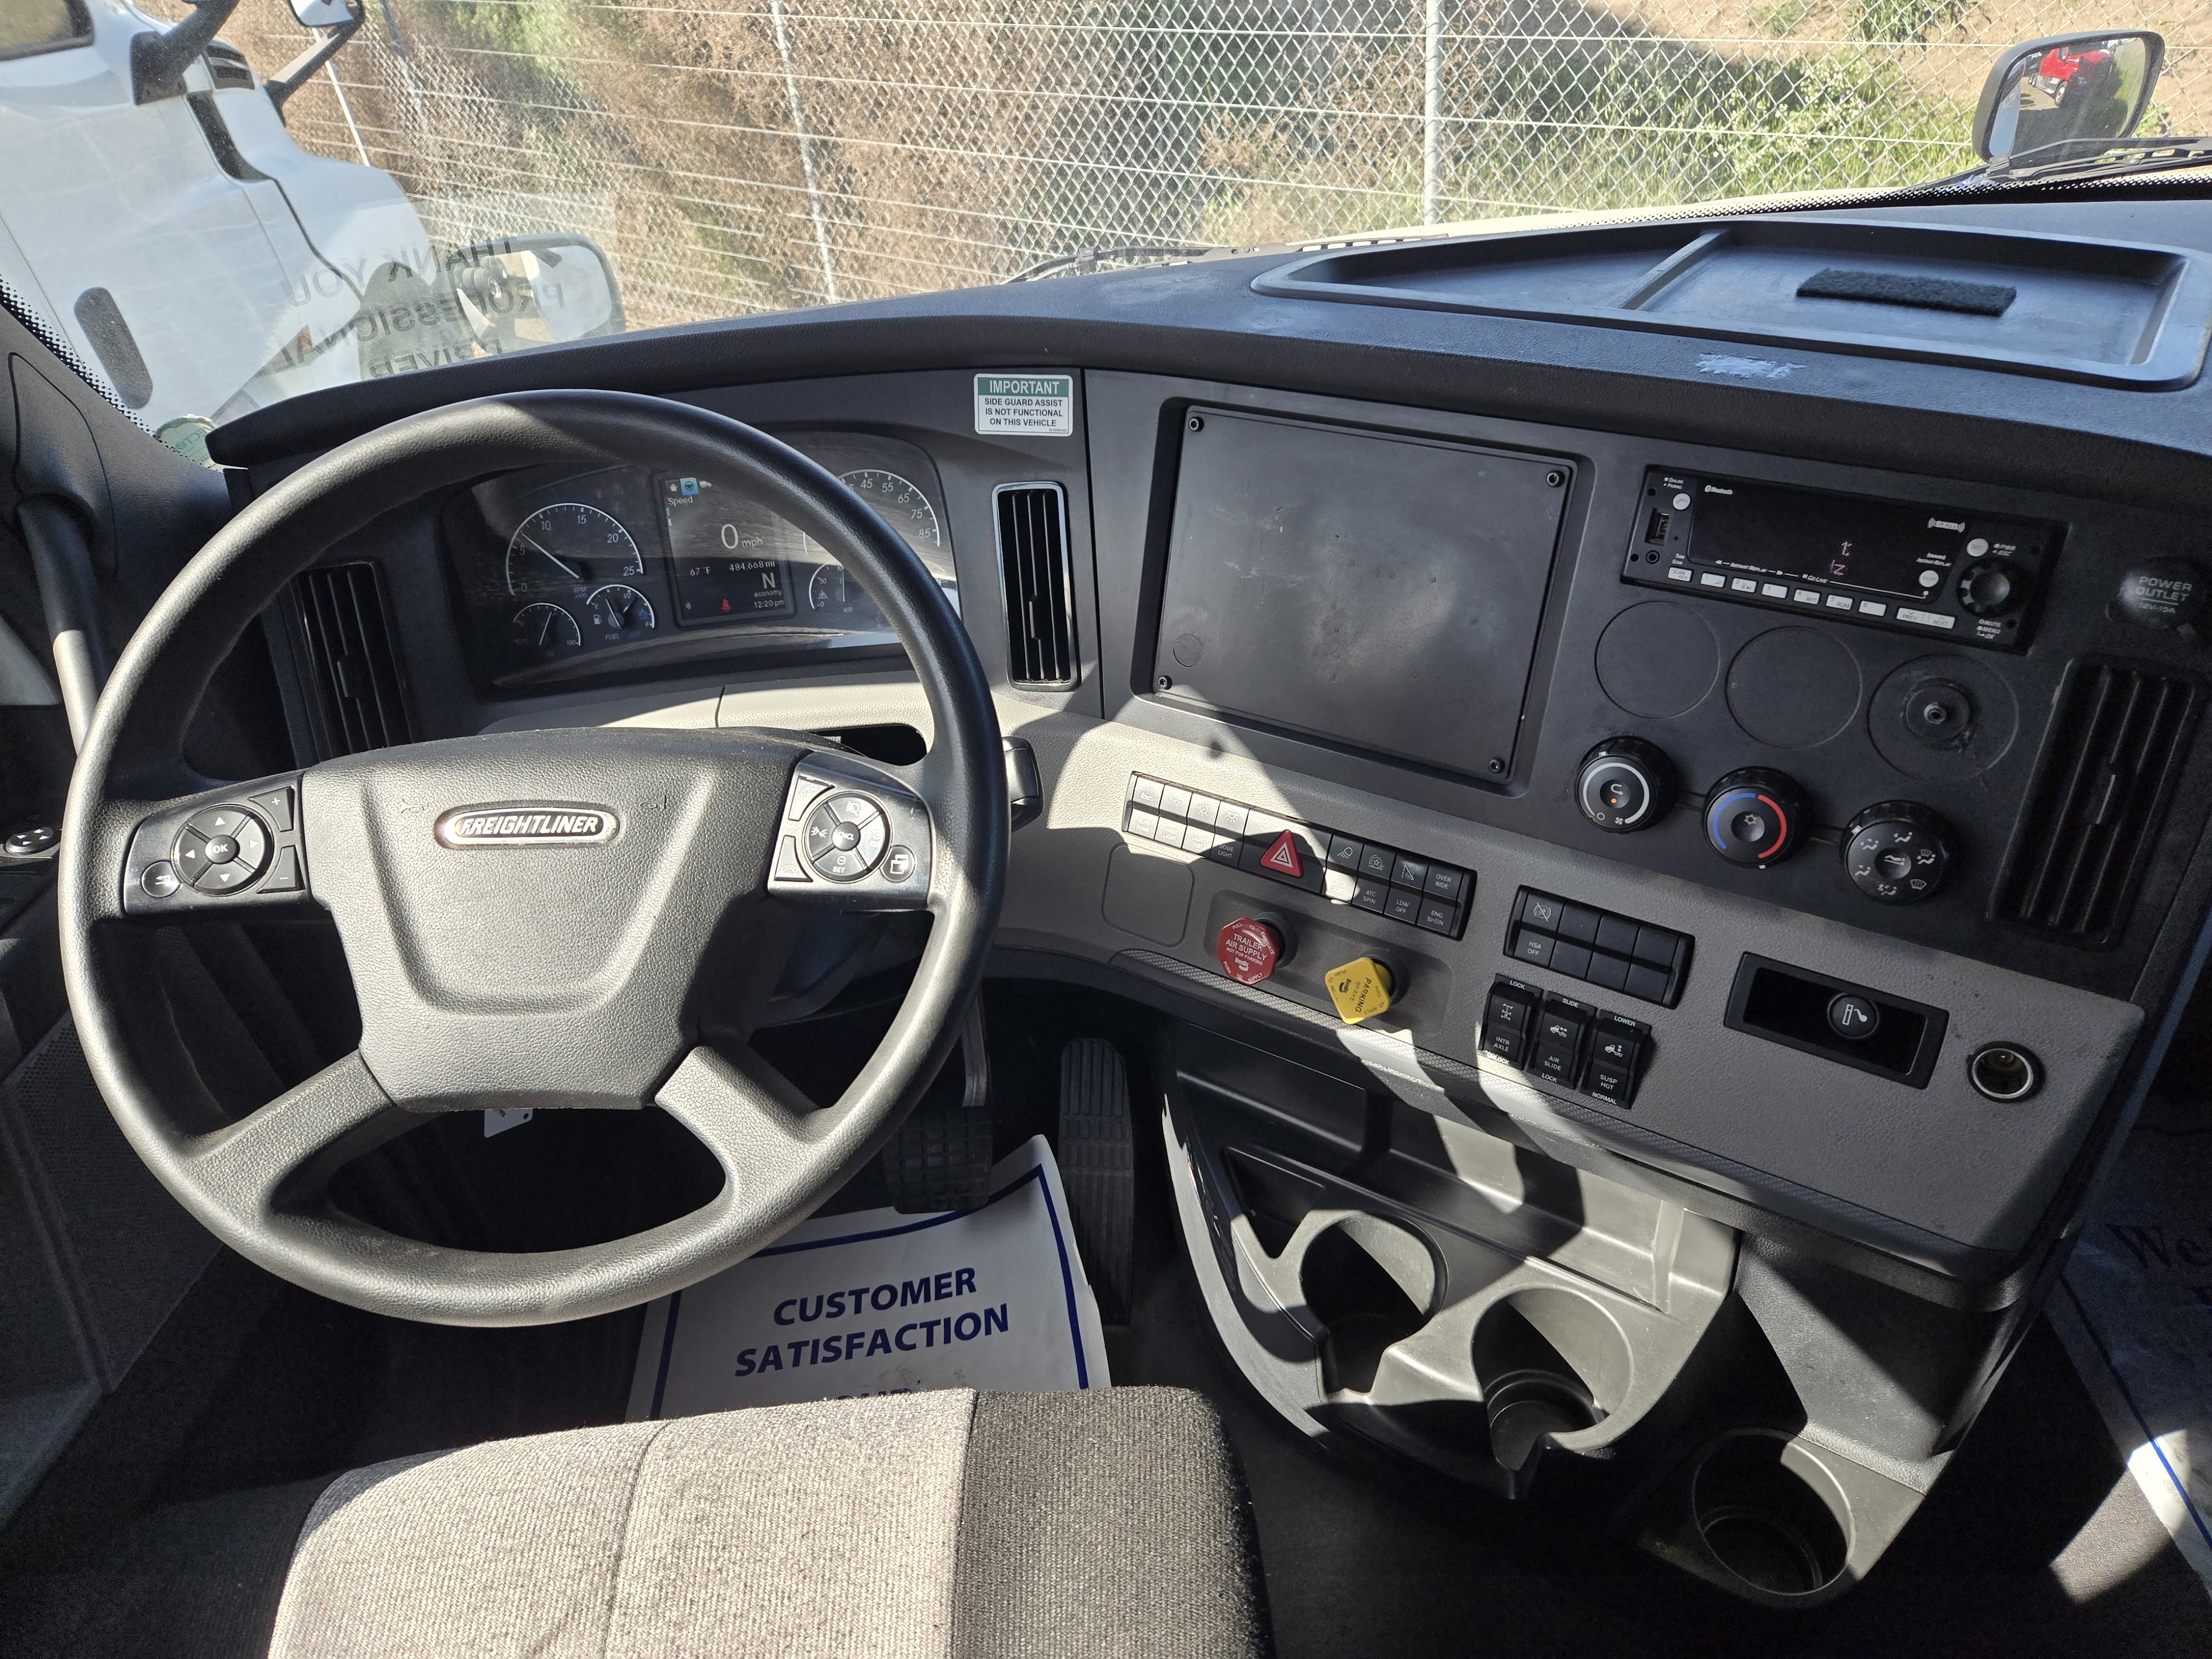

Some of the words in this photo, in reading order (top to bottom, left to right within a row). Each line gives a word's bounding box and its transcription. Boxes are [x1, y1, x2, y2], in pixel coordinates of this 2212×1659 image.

[989, 380, 1060, 394] IMPORTANT
[860, 478, 873, 489] 45
[882, 482, 894, 493] 55
[668, 495, 693, 507] Speed
[898, 493, 910, 503] 65
[911, 509, 923, 519] 75
[577, 515, 587, 524] 15
[541, 520, 552, 531] 10
[607, 533, 619, 544] 20
[721, 524, 739, 549] 0
[742, 537, 763, 549] mph
[919, 529, 931, 539] 85
[519, 545, 525, 555] 5
[765, 559, 776, 568] mi
[623, 566, 635, 576] 25
[690, 567, 700, 576] 67
[762, 572, 776, 589] N
[2139, 576, 2193, 592] POWER
[521, 583, 528, 592] 0
[754, 589, 782, 598] economy
[2136, 586, 2190, 601] OUTLET
[754, 599, 774, 609] 12:20
[775, 599, 785, 608] pm
[460, 815, 599, 836] FREIGHTLINER
[1136, 825, 1150, 833] DOME
[1162, 833, 1177, 842] LIGHT
[1192, 834, 1206, 843] LIGHT
[210, 843, 229, 854] OK
[1191, 841, 1204, 849] TEST
[1219, 843, 1234, 852] DOME
[1218, 850, 1233, 859] LIGHT
[1436, 874, 1452, 883] OVER
[1330, 885, 1347, 895] LIGHT
[1435, 881, 1449, 890] RIDE
[1363, 896, 1376, 904] SPIN
[1396, 899, 1410, 908] LDW
[1431, 910, 1443, 919] ENG
[1427, 916, 1444, 926] SHDN
[1234, 933, 1263, 952] TRAILER
[1528, 941, 1542, 950] HSA
[1225, 939, 1238, 949] AIR
[1239, 945, 1267, 961] SUPPLY
[1527, 948, 1540, 956] OFF
[1235, 957, 1249, 967] Bendix
[1244, 954, 1263, 966] PARKING
[1223, 961, 1232, 973] PUSH
[1248, 972, 1263, 983] SUPPLY
[1509, 980, 1526, 990] LOCK
[1349, 980, 1360, 1002] BRAKE
[1355, 978, 1372, 1013] PARKING
[1374, 985, 1383, 998] PULL
[1562, 998, 1579, 1008] SLIDE
[1364, 1006, 1378, 1015] APPLY
[1614, 1015, 1636, 1027] LOWER
[1496, 1036, 1510, 1046] INTR
[1493, 1044, 1510, 1052] AXLE
[1486, 1052, 1510, 1066] UNLOCK
[1548, 1055, 1560, 1063] AIR
[1544, 1061, 1562, 1071] SLIDE
[1542, 1073, 1557, 1083] LOCK
[1599, 1074, 1618, 1084] SUSP
[1600, 1081, 1614, 1091] HGT
[1592, 1092, 1617, 1105] NORMAL
[774, 1267, 977, 1327] CUSTOMER
[734, 1303, 1009, 1378] SATISFACTION
